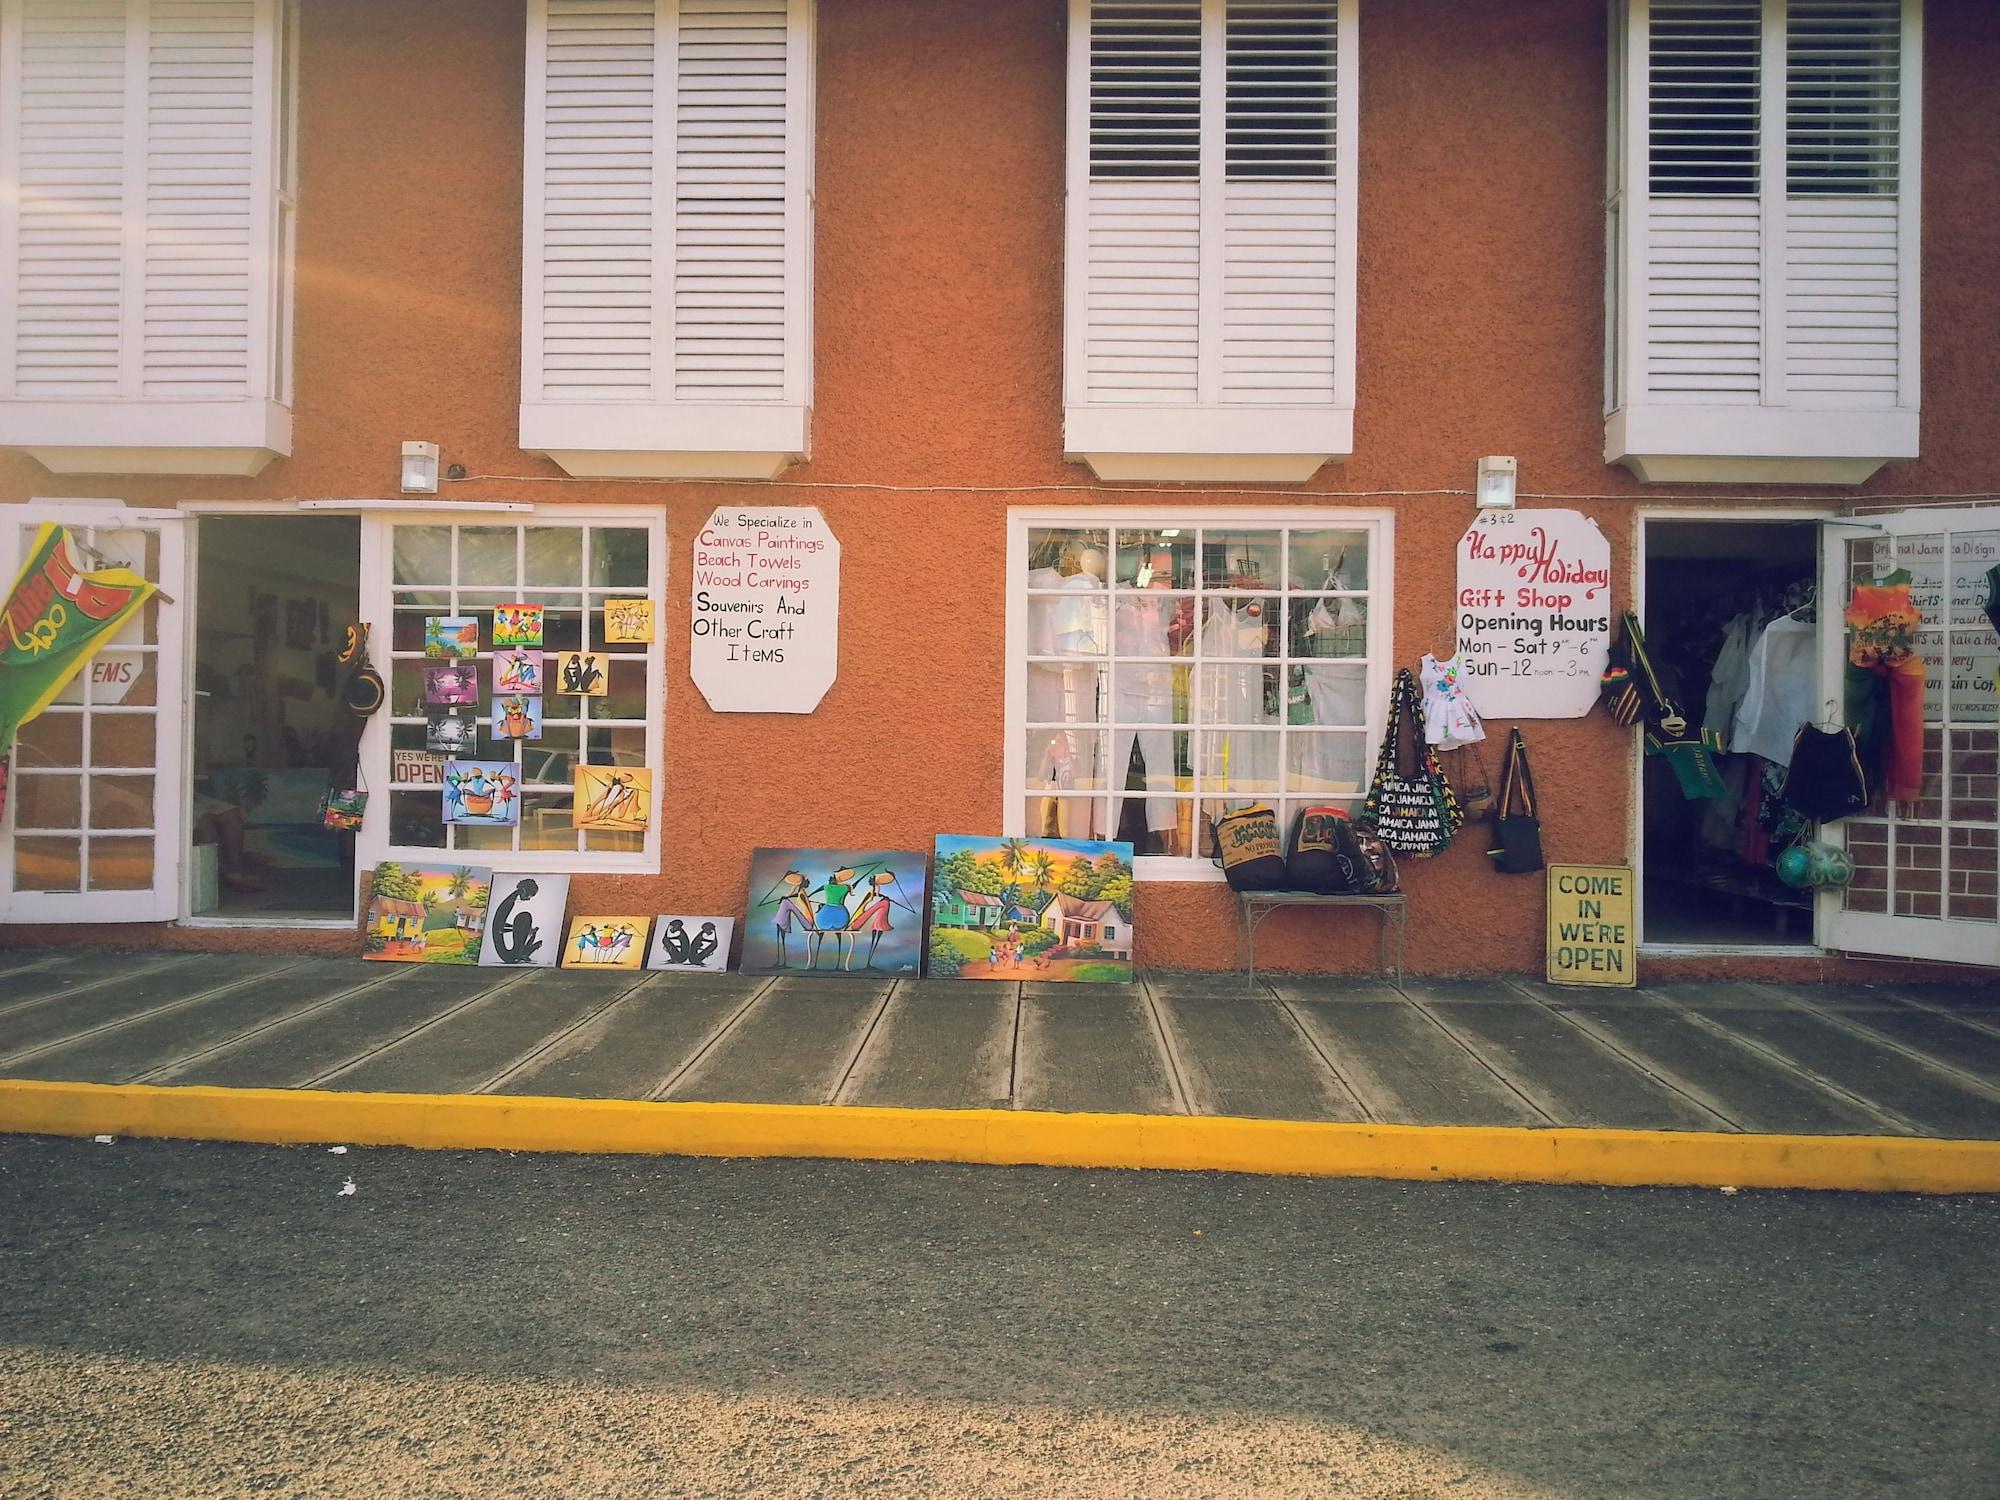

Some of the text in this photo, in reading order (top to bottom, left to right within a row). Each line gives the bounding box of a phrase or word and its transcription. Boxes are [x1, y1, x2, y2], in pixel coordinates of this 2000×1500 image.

[713, 514, 813, 531] We Specialize in
[700, 530, 825, 554] Canvas Paintings
[698, 552, 801, 569] Beach Towels
[1467, 527, 1608, 600] Happy Holiday
[697, 571, 810, 594] Wood Carvings
[697, 592, 805, 615] Souvenirs And
[1460, 588, 1572, 613] Gift Shop
[693, 618, 795, 640] Other Craft
[1461, 612, 1608, 637] Opening Hours
[1459, 637, 1492, 654] Mon
[1513, 637, 1548, 655] Sat
[1465, 659, 1498, 676] Sun
[395, 752, 413, 761] YES
[397, 763, 444, 784] OPEN
[1559, 875, 1623, 895] COME
[1578, 900, 1601, 918] IN
[1559, 921, 1625, 944] WE'RE
[1558, 946, 1623, 972] OPEN
